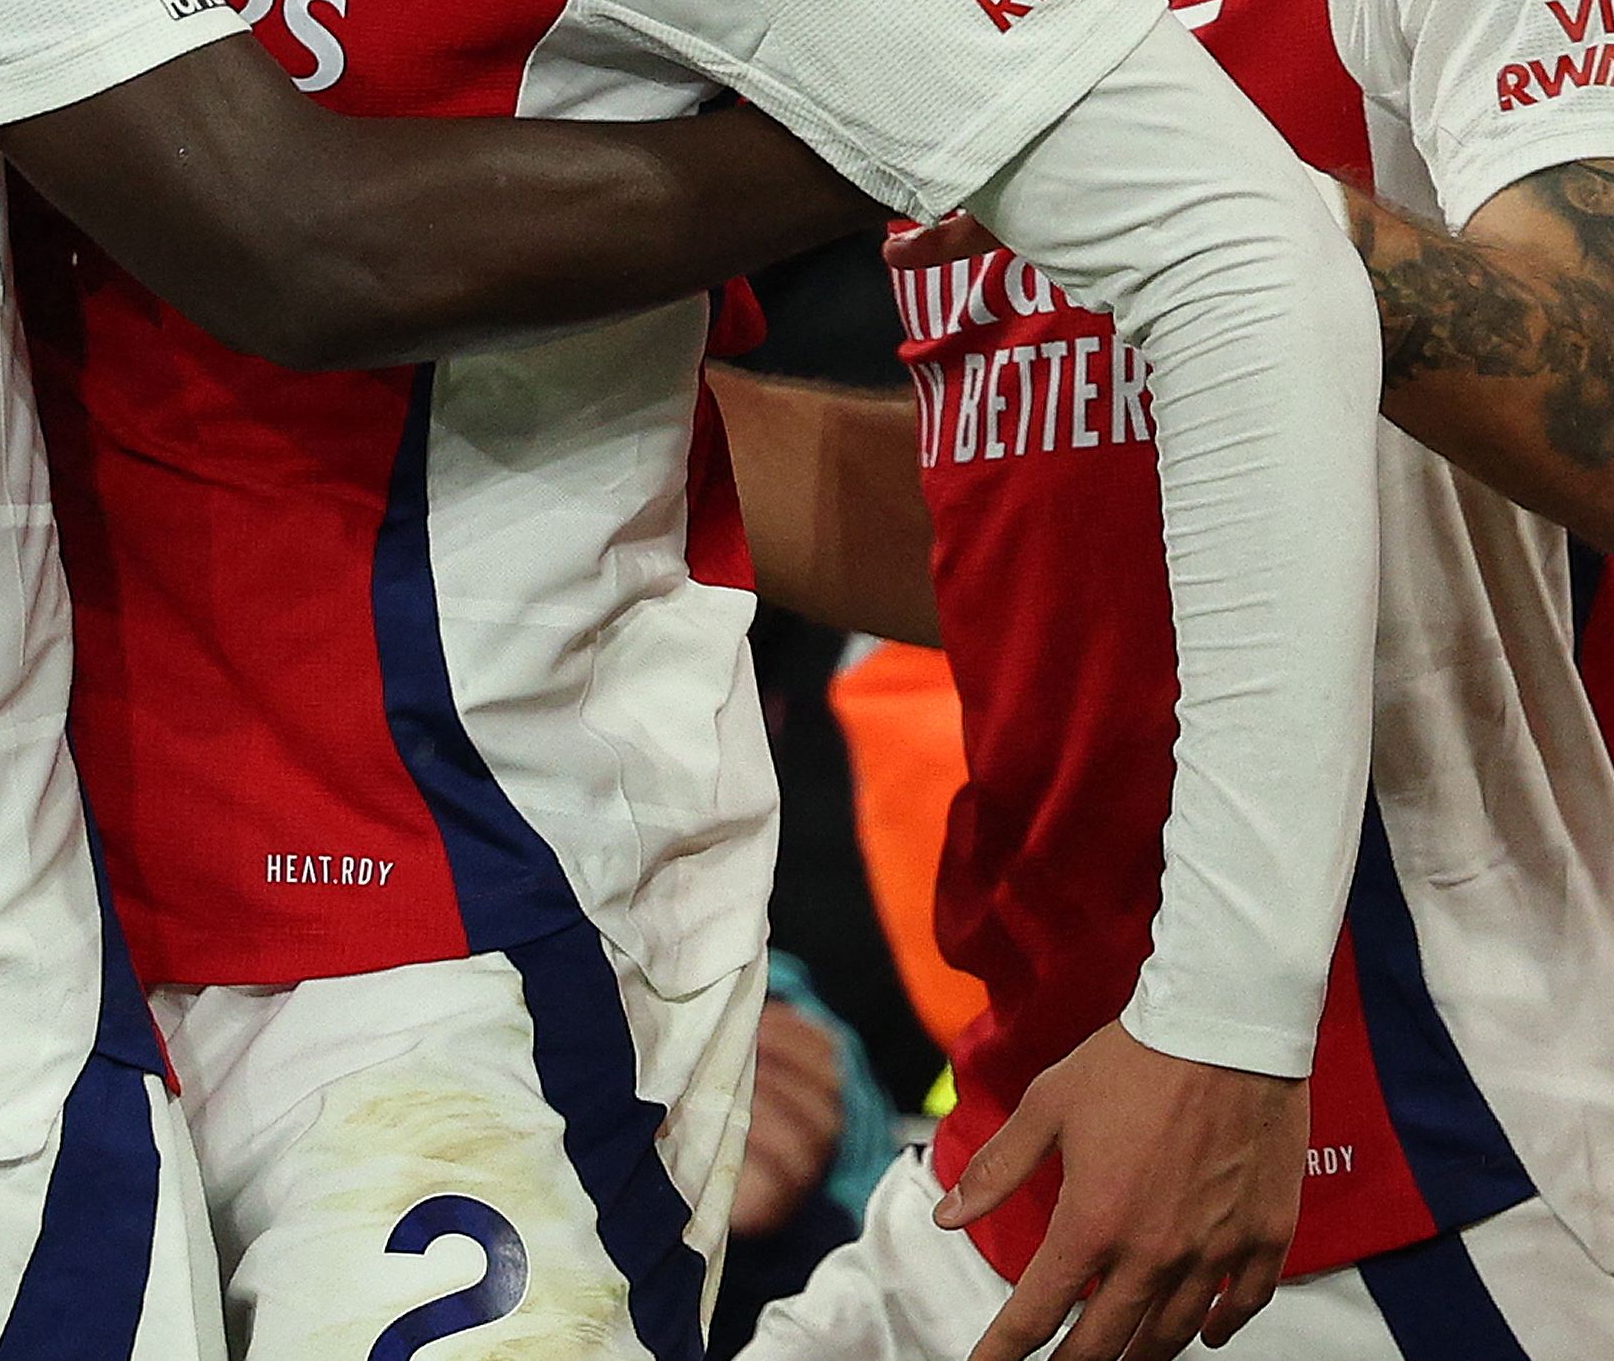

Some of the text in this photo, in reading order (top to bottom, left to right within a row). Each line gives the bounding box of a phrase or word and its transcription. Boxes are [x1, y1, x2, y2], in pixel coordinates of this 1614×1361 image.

[953, 335, 1151, 464] BETTER
[266, 853, 394, 887] HEAT.RDY
[366, 1192, 531, 1361] 2
